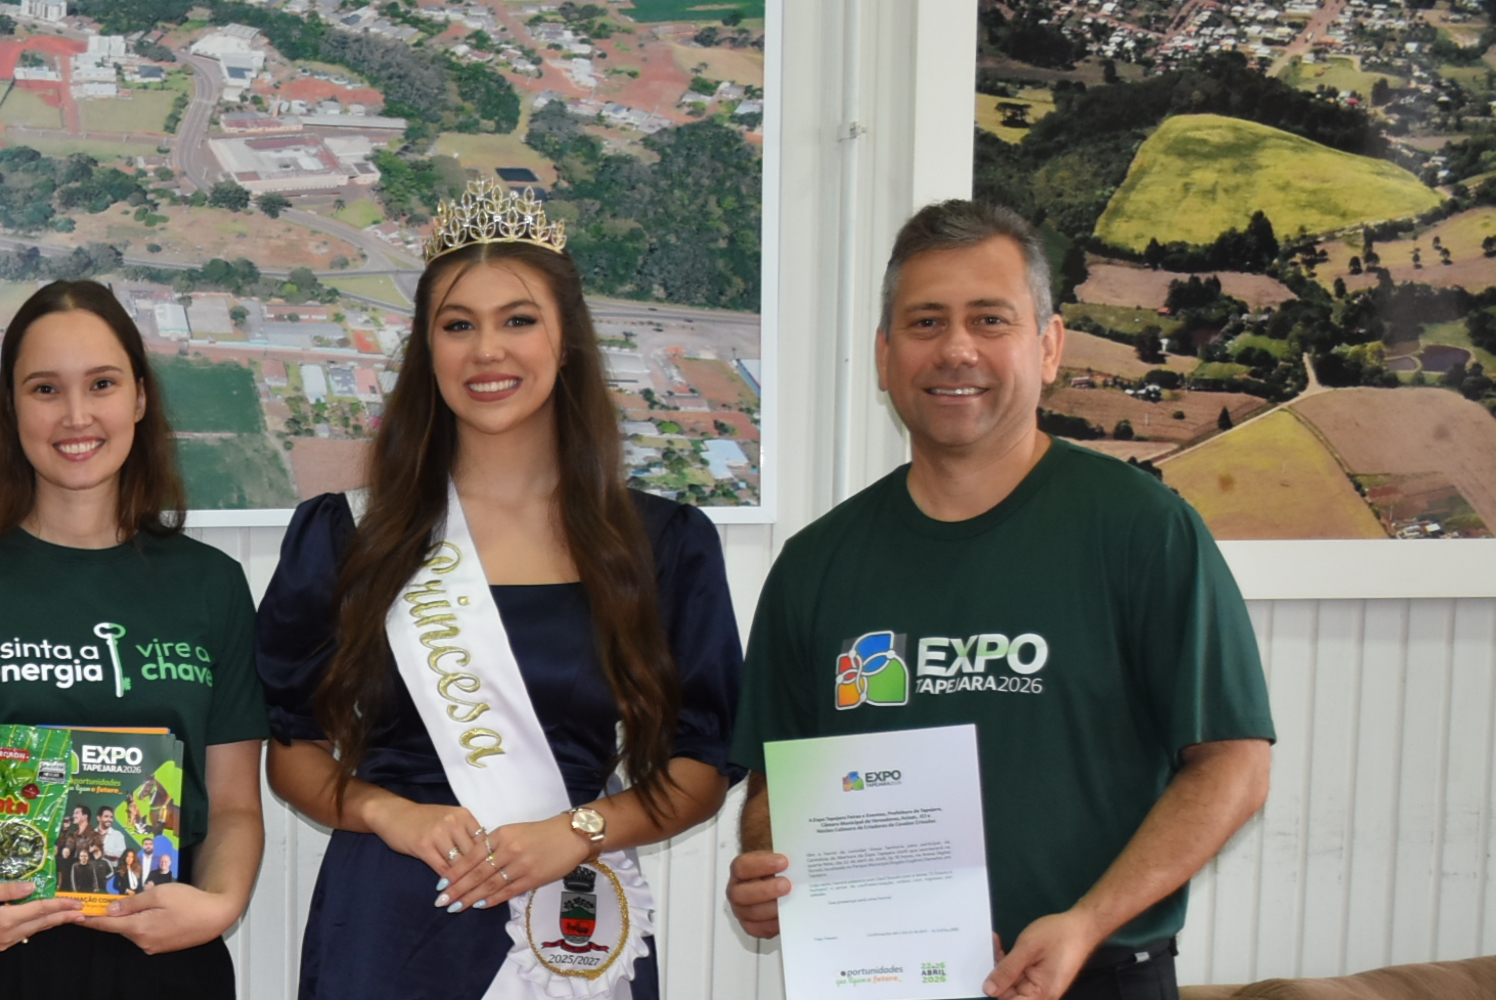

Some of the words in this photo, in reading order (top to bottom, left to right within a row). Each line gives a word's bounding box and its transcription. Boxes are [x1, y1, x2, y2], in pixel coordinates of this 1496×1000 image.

[0, 638, 72, 660] sinta
[80, 645, 99, 659] a
[136, 639, 190, 658] vire
[196, 646, 210, 662] a
[916, 633, 1048, 677] EXPO
[141, 656, 213, 687] chave
[82, 745, 142, 765] EXPO
[865, 770, 901, 782] EXPO
[548, 954, 600, 965] 2025/2027
